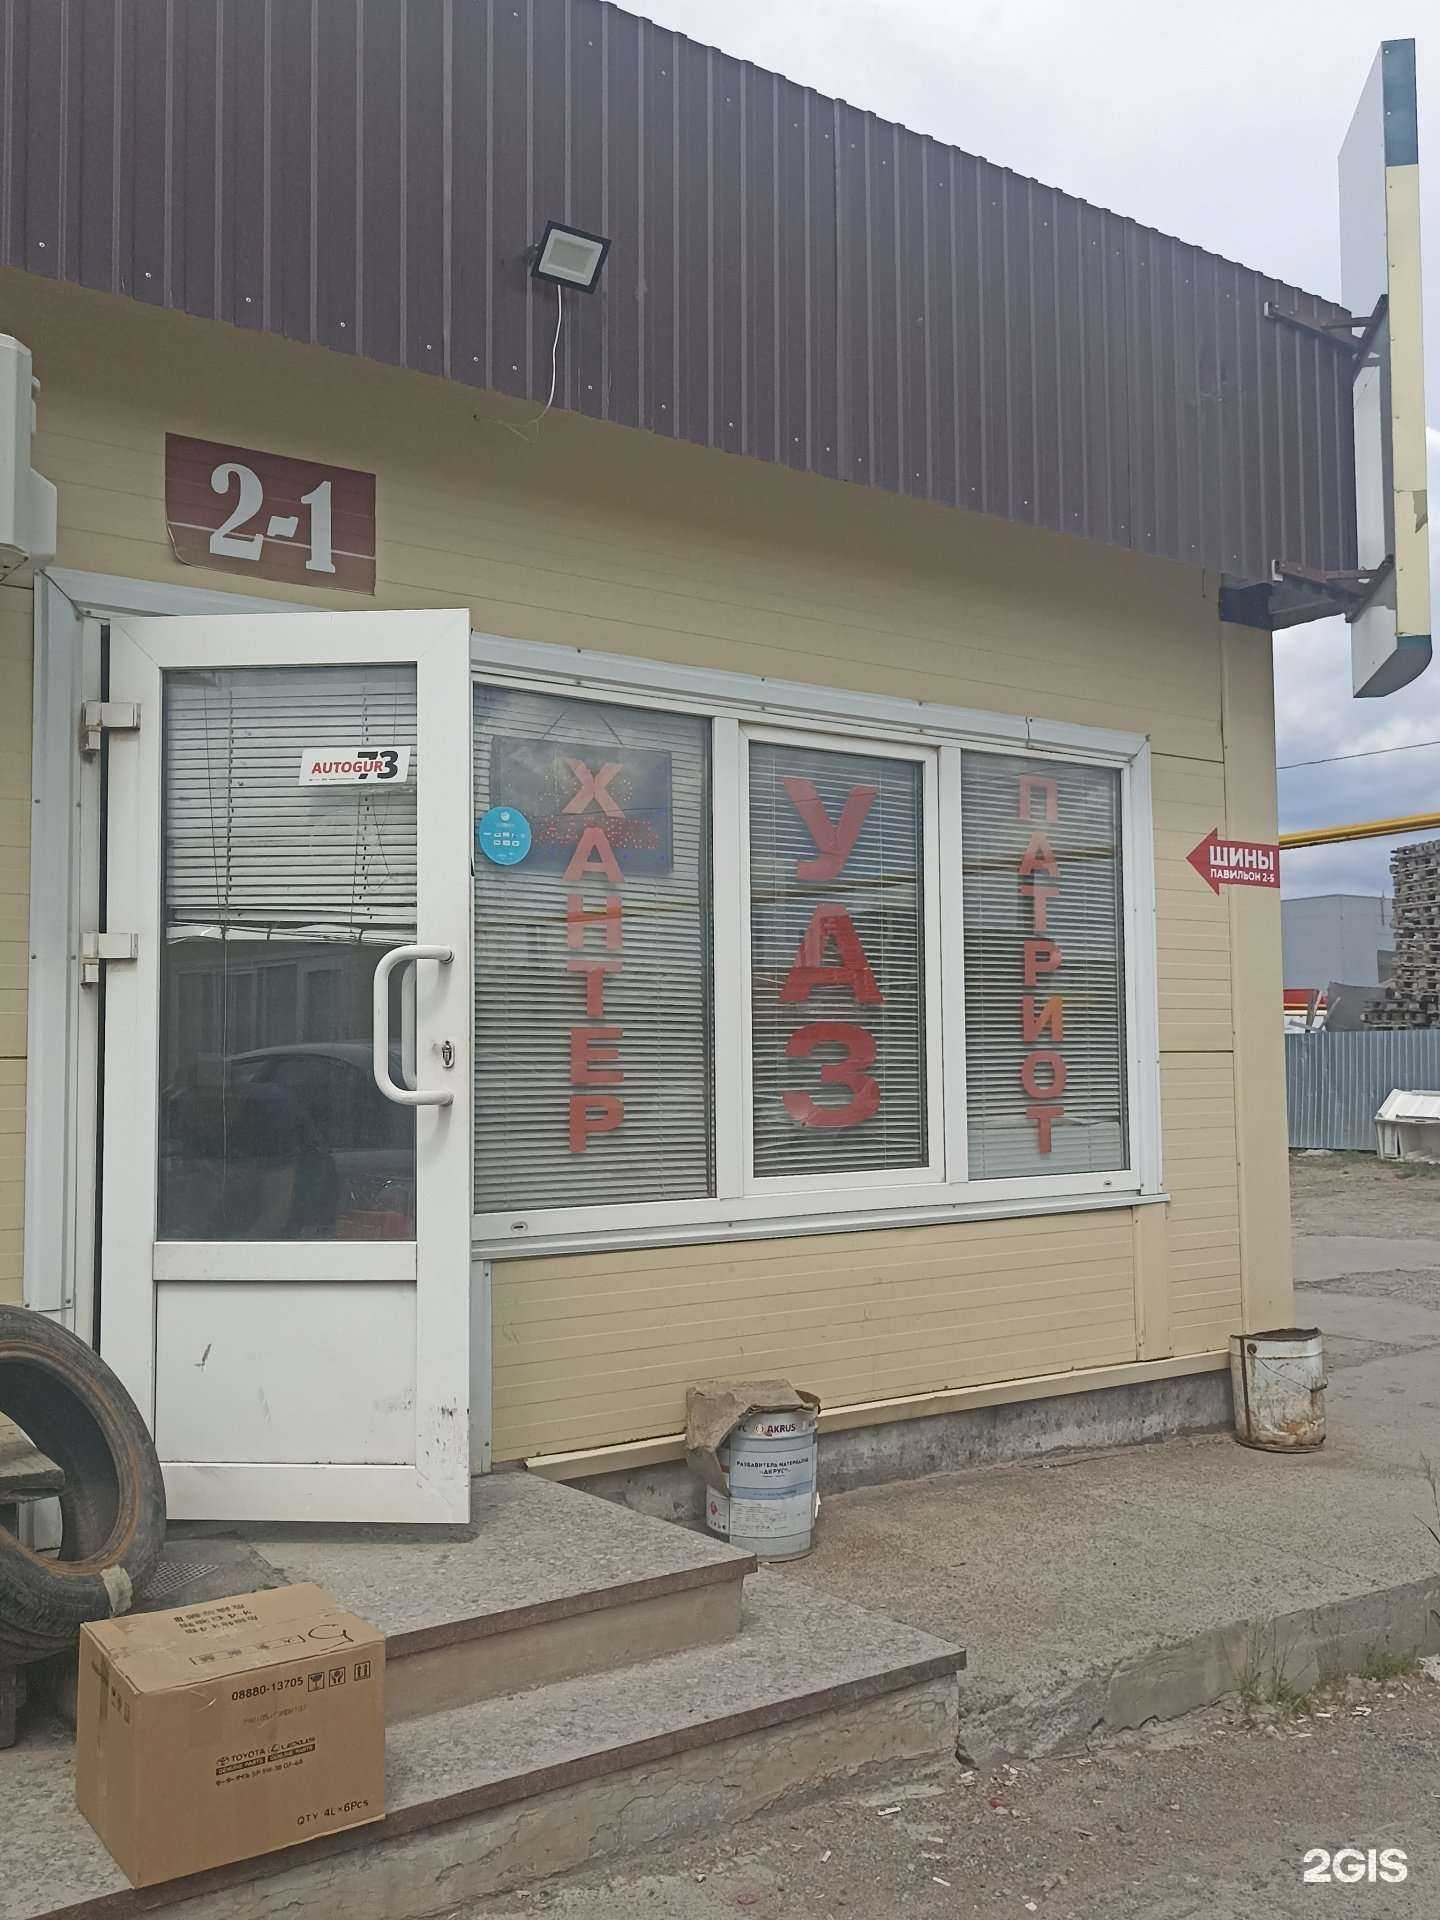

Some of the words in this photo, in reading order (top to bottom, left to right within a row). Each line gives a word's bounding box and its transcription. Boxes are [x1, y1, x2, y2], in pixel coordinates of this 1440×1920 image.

[209, 463, 336, 574] 2-1
[311, 761, 384, 774] AUTOGUR
[1209, 845, 1274, 871] ШИНЫ
[1210, 868, 1261, 882] ПАВИЛЬОН
[562, 757, 626, 1154] ХАНТЕР
[779, 777, 885, 1128] УАЗ
[1017, 774, 1068, 1156] ПАТРИОТ
[767, 1423, 797, 1433] AKRUS
[231, 1676, 304, 1701] 08880-13705
[231, 1748, 266, 1762] TOYOTA
[297, 1812, 318, 1825] QTY
